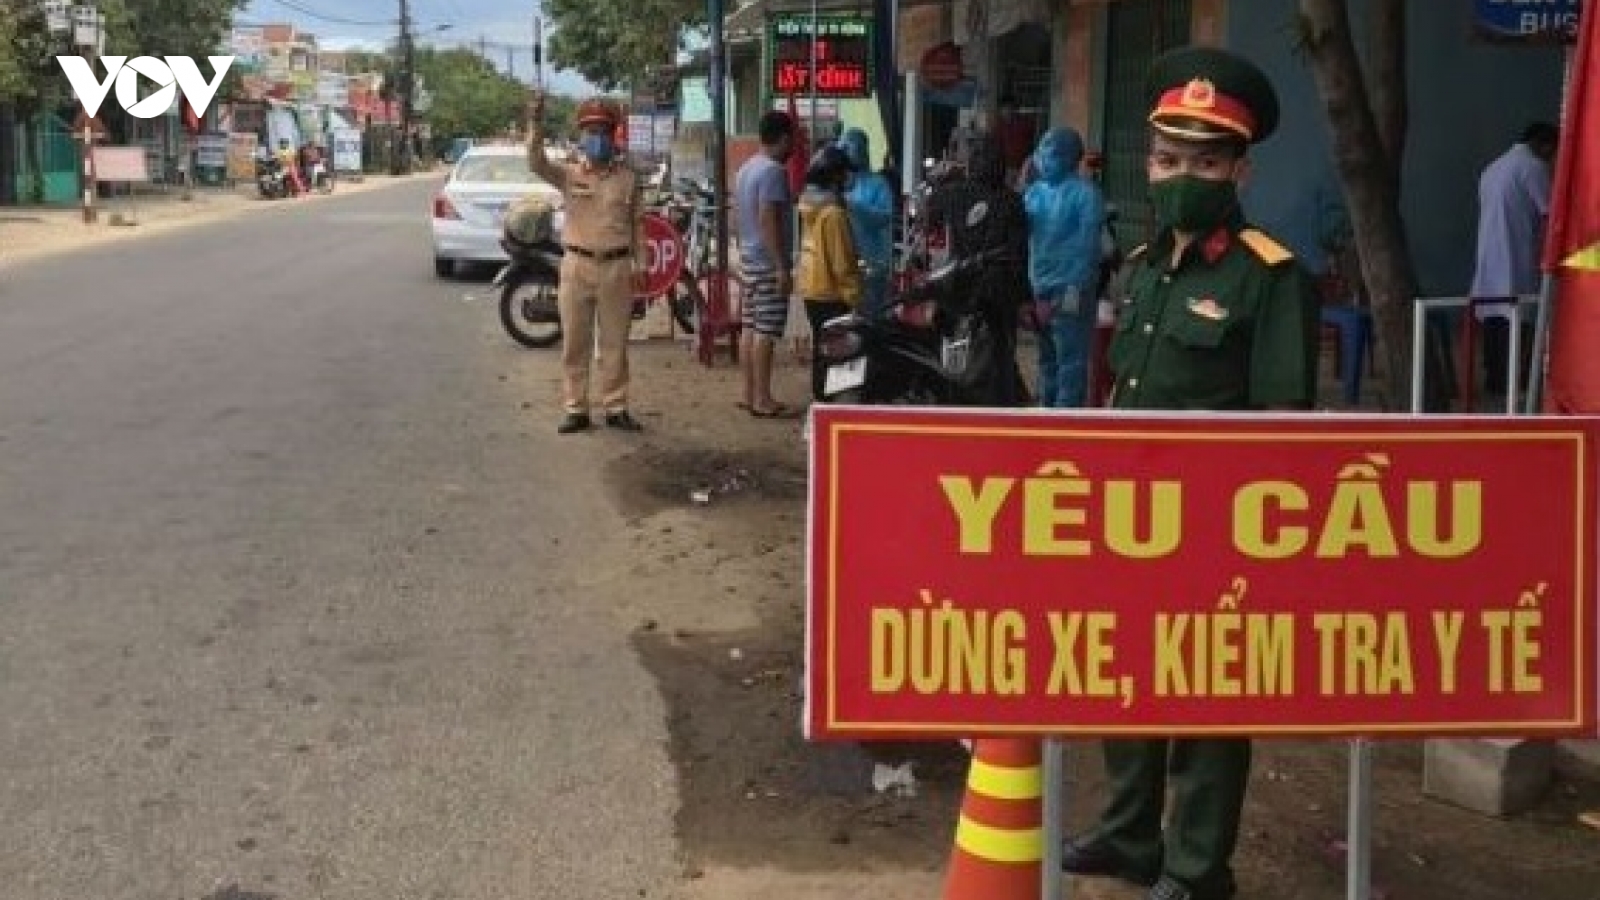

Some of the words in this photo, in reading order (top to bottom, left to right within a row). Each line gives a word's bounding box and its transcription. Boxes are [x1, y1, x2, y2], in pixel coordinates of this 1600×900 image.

[646, 238, 676, 275] OP
[939, 460, 1182, 558] YÊU
[1233, 453, 1482, 559] CẦU
[870, 588, 1026, 695] DỪNG
[1046, 612, 1135, 708] XE,
[1154, 577, 1295, 697] KIỂM
[1314, 612, 1414, 695] TRA
[1432, 611, 1465, 693] Y
[1481, 582, 1547, 693] TẾ
